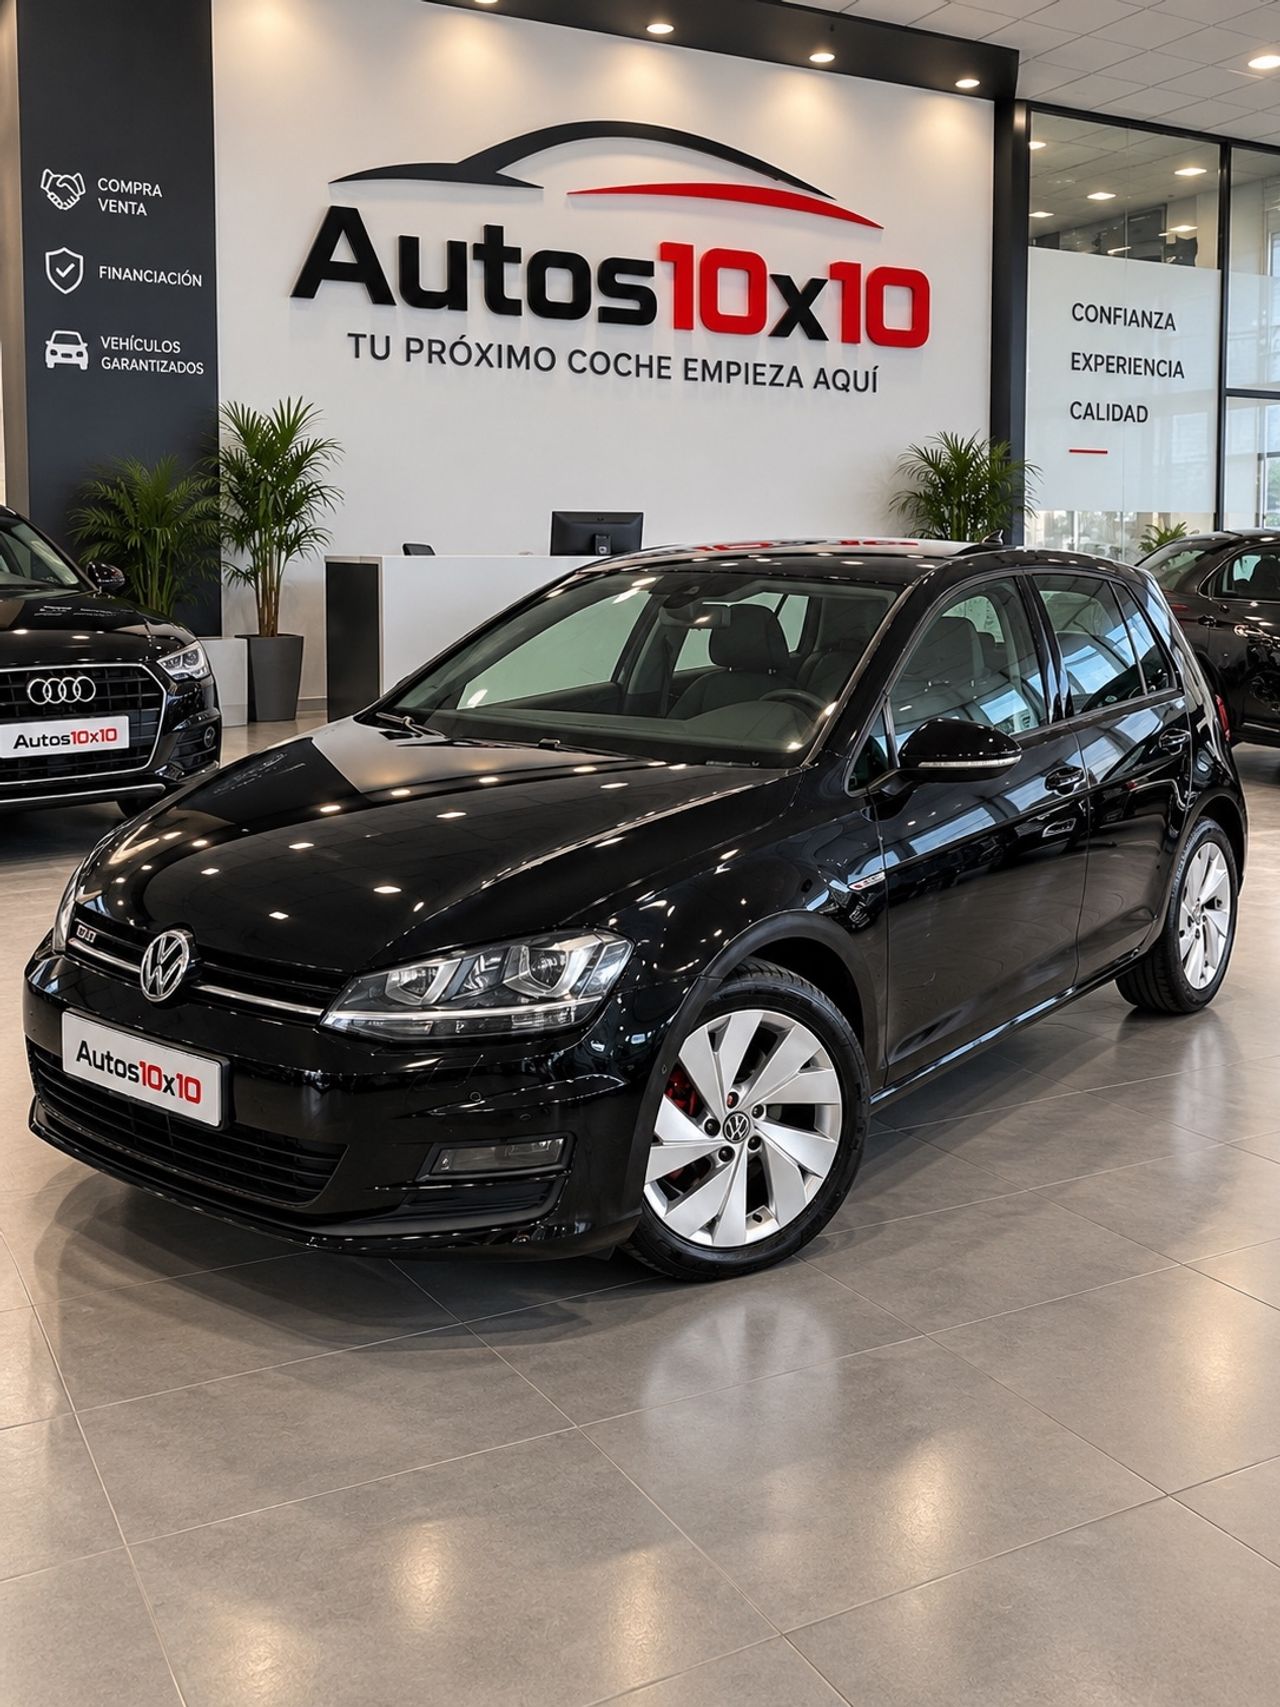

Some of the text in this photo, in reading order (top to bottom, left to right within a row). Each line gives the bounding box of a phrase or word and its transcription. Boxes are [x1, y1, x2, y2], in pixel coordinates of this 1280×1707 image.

[97, 177, 163, 198] COMPRA
[97, 197, 148, 216] VENTA
[98, 265, 203, 288] FINANCIACIÓN
[290, 205, 931, 350] Autos10x10
[1071, 302, 1177, 332] CONFIANZA
[100, 334, 182, 355] VEHÍCULOS
[101, 356, 205, 376] GARANTIZADOS
[347, 332, 879, 394] TU PRÓXIMO COCHE EMPIEZA AQUÍ
[1070, 351, 1185, 379] EXPERIENCIA
[1069, 400, 1149, 424] CALIDAD
[13, 728, 118, 750] Autos10x10
[75, 1039, 203, 1106] Autos10x10
